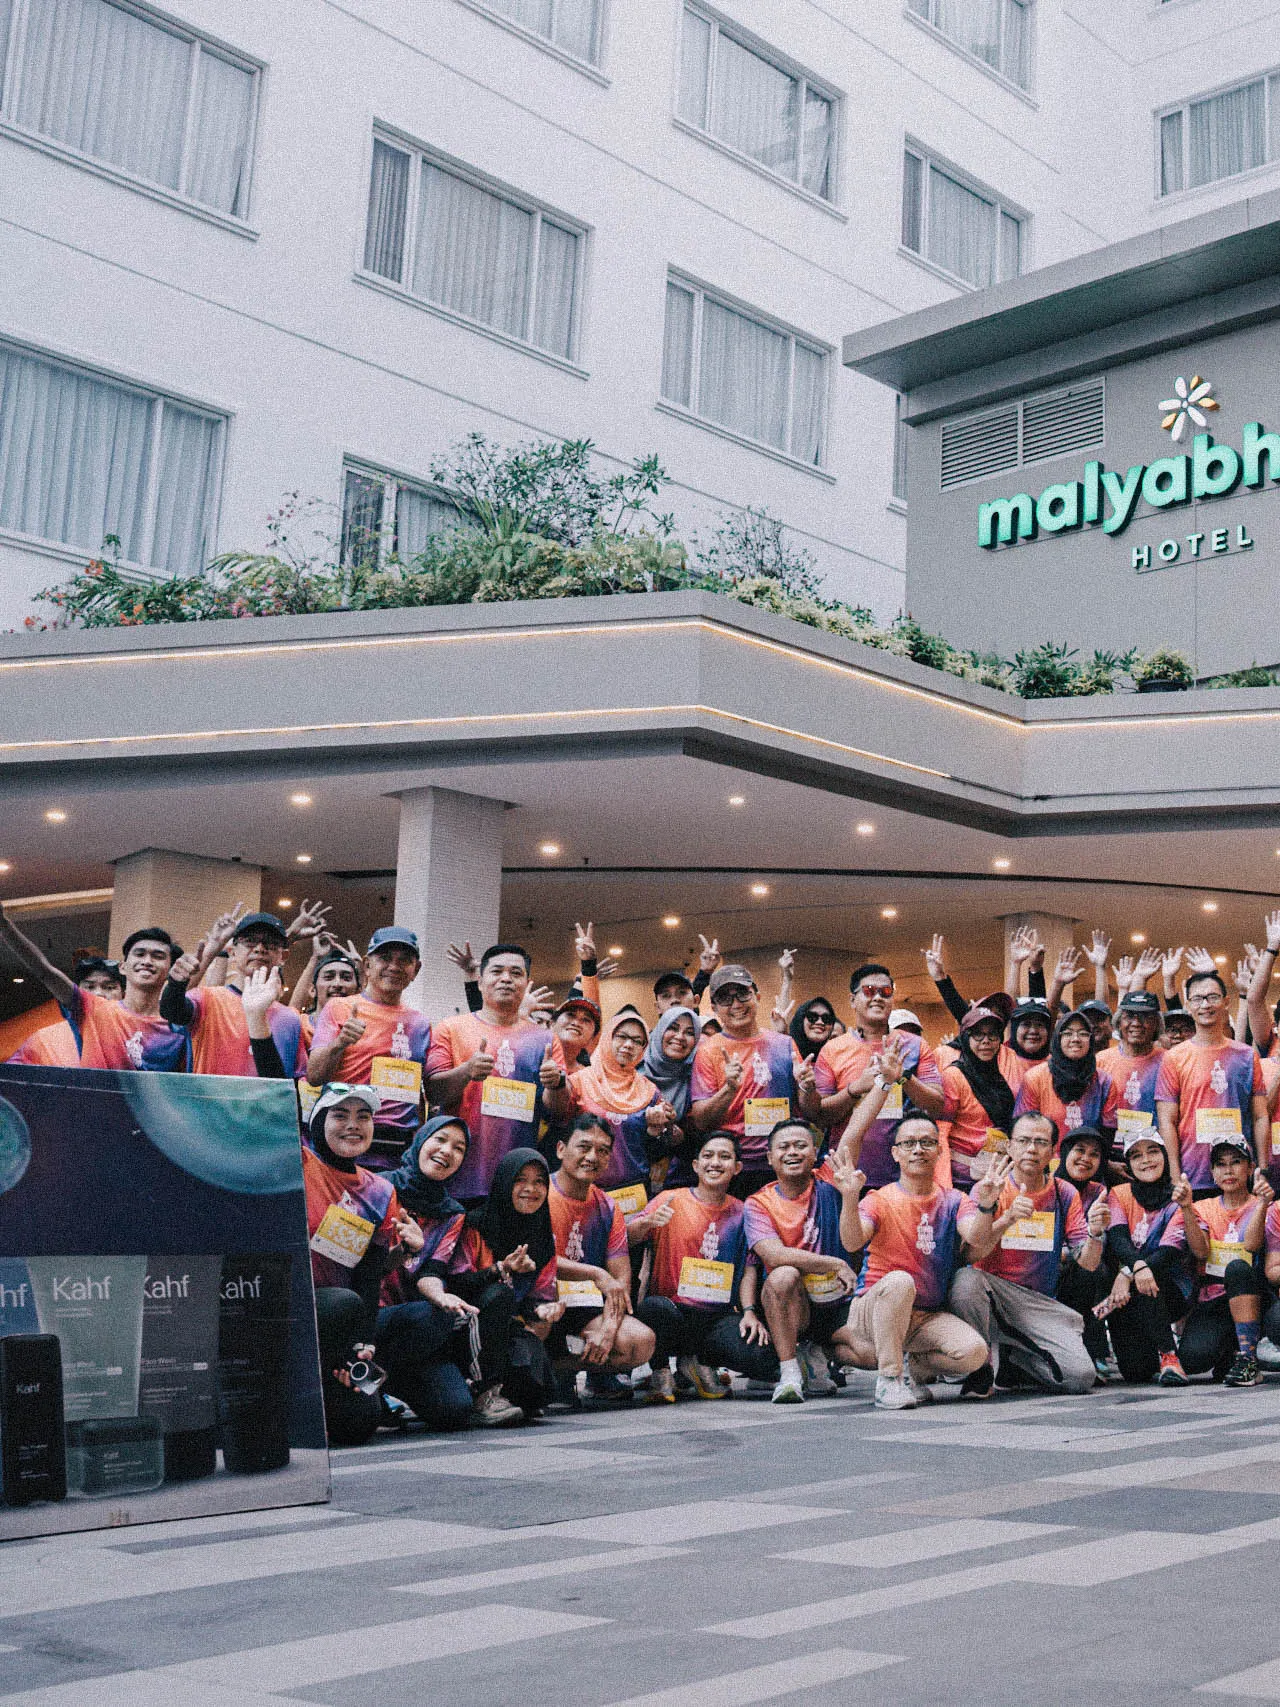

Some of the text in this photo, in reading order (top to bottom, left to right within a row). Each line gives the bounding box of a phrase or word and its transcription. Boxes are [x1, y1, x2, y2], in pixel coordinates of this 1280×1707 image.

[1131, 525, 1254, 570] HOTEL
[0, 1283, 28, 1308] hf
[52, 1275, 112, 1301] Kahf
[220, 1275, 262, 1299] ahf
